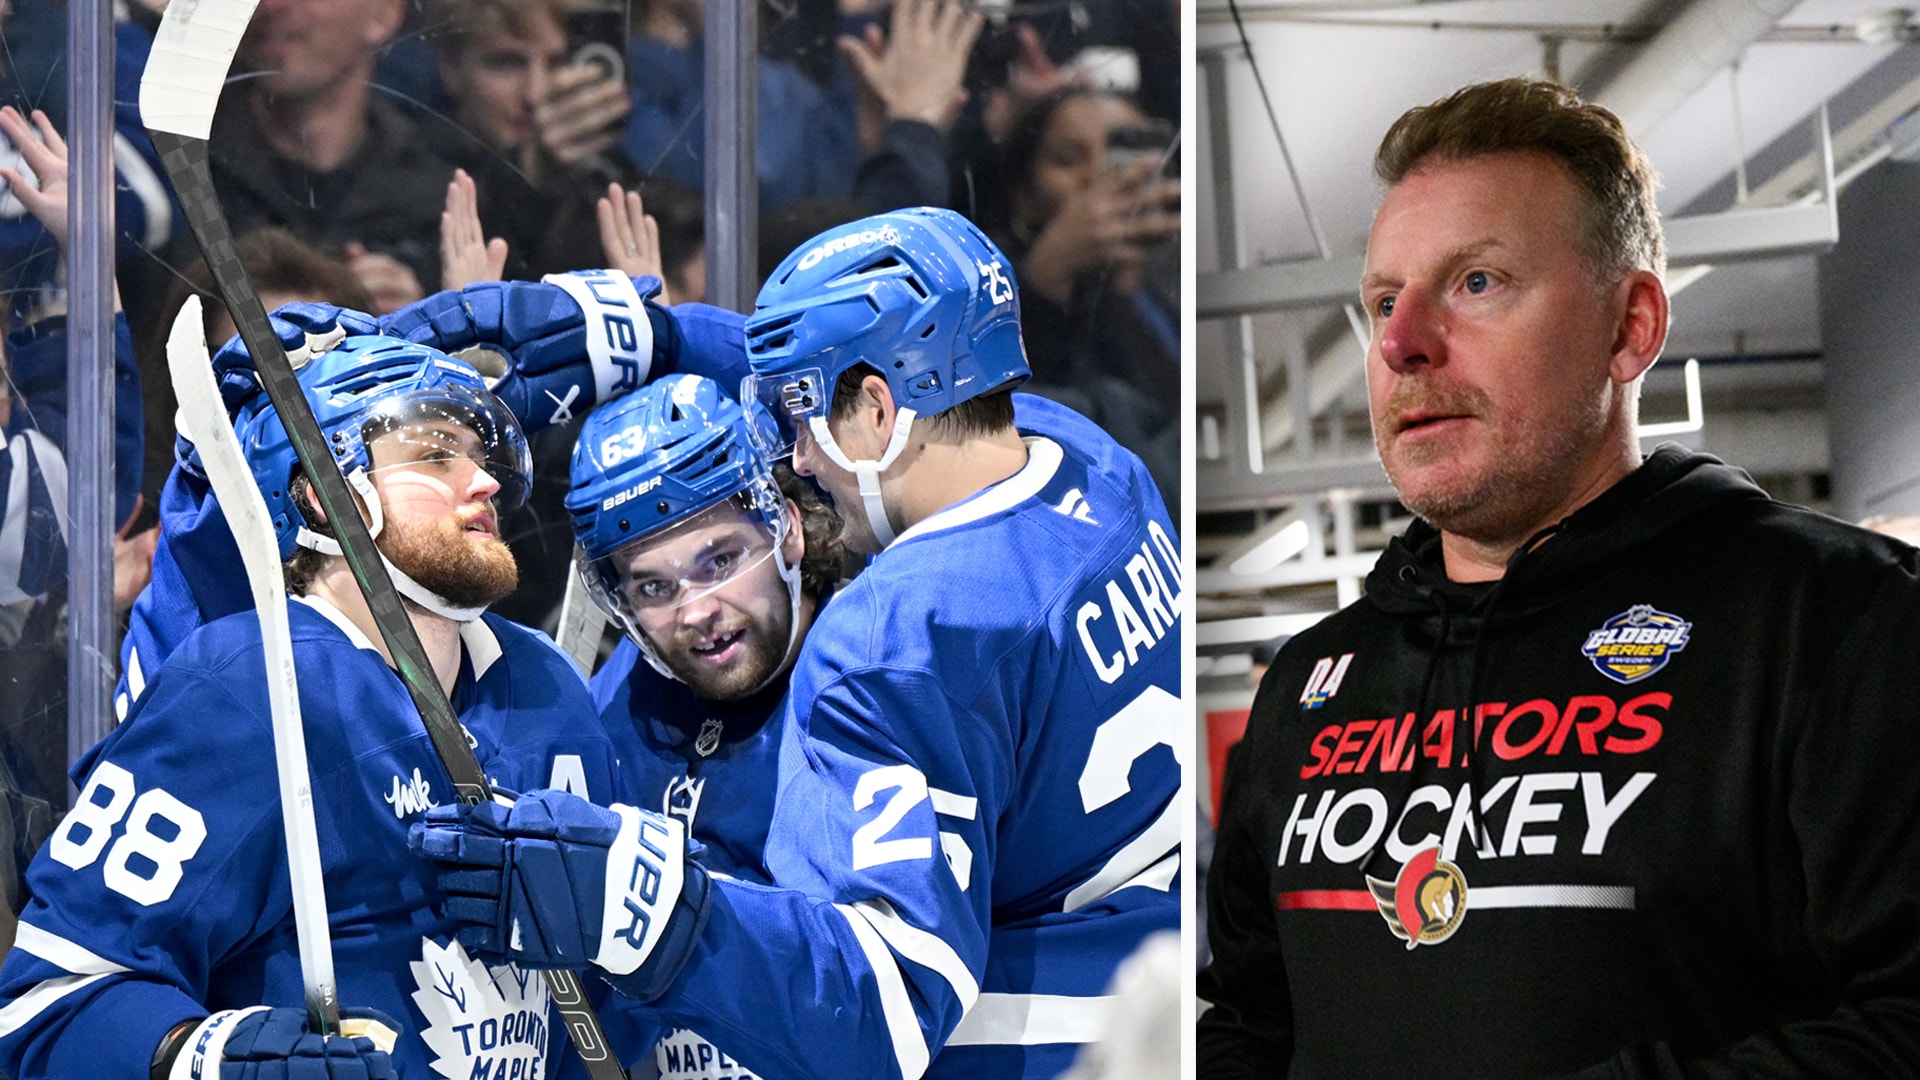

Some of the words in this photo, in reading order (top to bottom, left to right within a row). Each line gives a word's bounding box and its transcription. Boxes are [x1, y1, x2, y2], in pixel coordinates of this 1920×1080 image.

[797, 230, 877, 270] OREO
[979, 261, 1013, 305] 25
[567, 269, 639, 392] UER
[601, 425, 645, 467] 63
[603, 475, 662, 511] BAUER
[1076, 519, 1181, 684] CARLO
[1585, 626, 1687, 650] GLOBAL
[1595, 643, 1667, 656] SERIES
[1300, 691, 1673, 779] SENATORS
[550, 754, 590, 803] A
[50, 760, 208, 907] 88
[1278, 771, 1658, 867] HOCKEY
[614, 806, 669, 950] UER
[452, 1010, 547, 1060] TORONTO
[664, 1043, 742, 1073] MAPL
[469, 1055, 541, 1080] MAPLE
